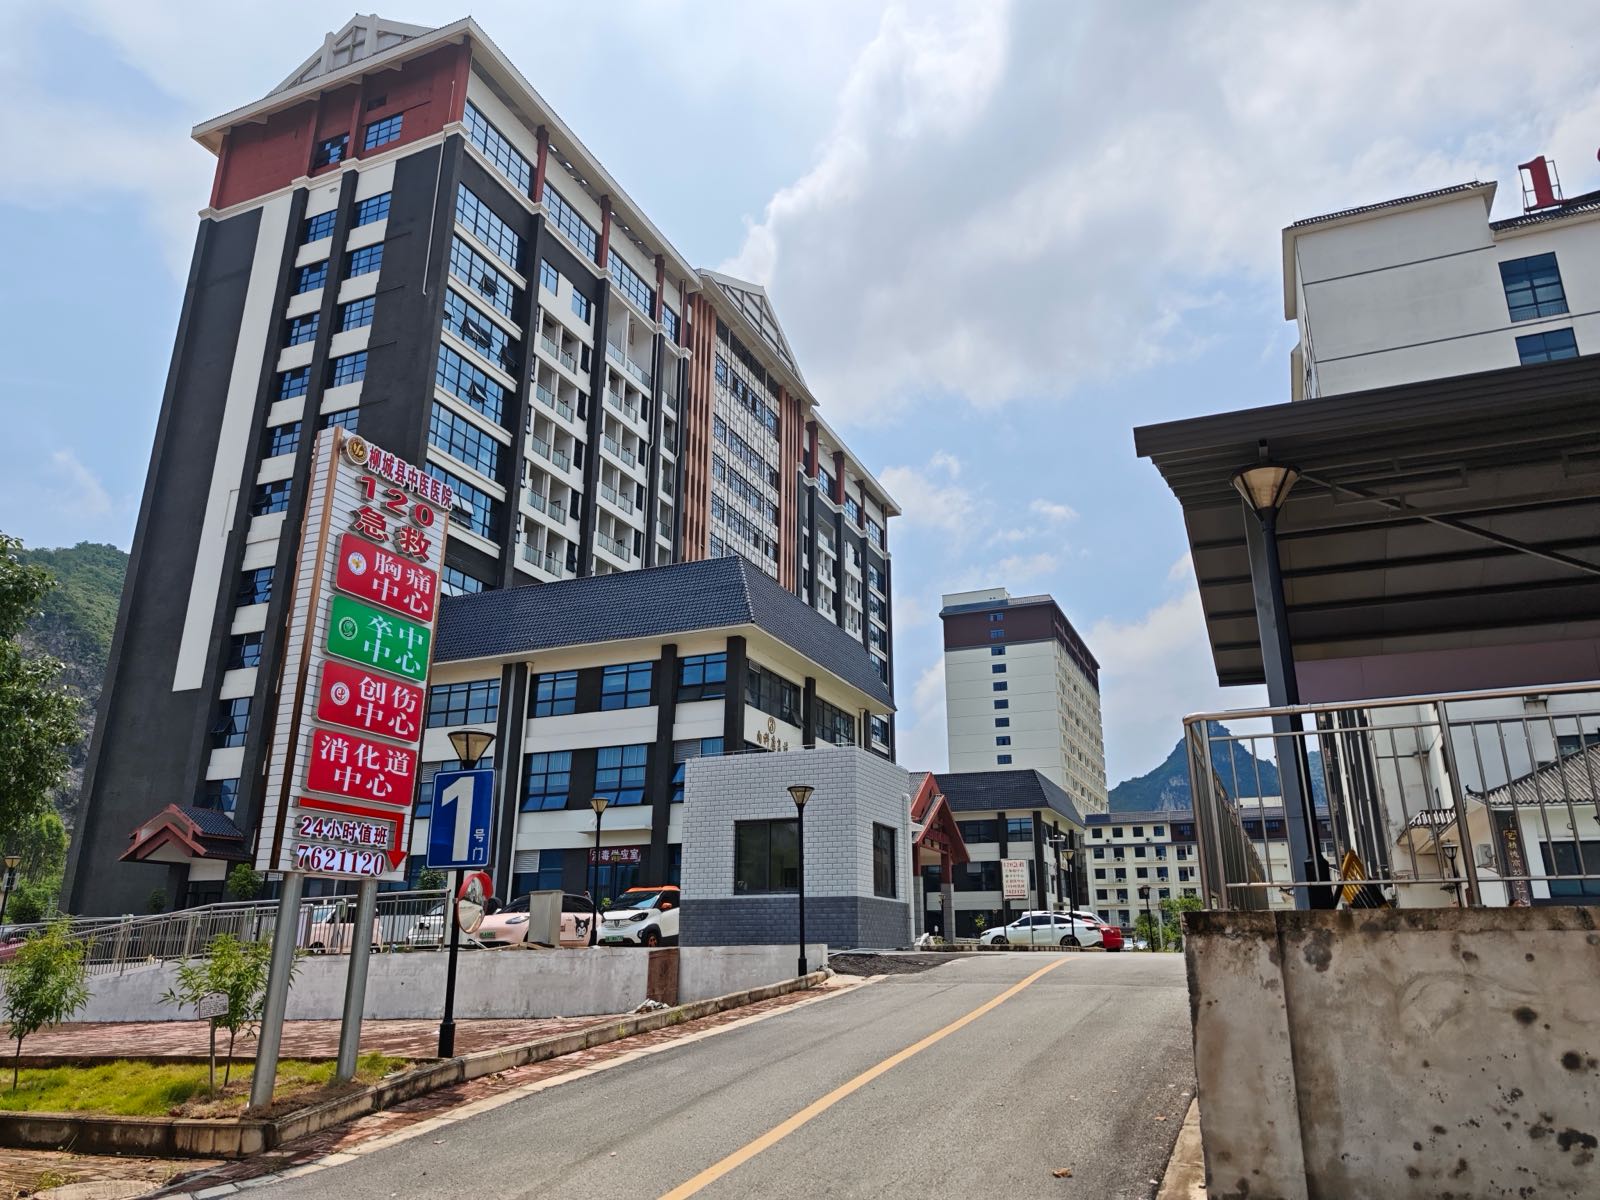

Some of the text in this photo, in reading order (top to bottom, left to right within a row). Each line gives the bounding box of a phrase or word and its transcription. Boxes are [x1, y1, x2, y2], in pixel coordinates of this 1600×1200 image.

[368, 445, 453, 510] 柳城县中医医院
[361, 476, 434, 527] 120
[354, 505, 431, 561] 急救
[374, 551, 431, 594] 胸痛
[372, 577, 429, 613] 中心
[367, 615, 424, 650] 卒中
[363, 639, 420, 673] 中心
[358, 676, 418, 713] 创伤
[356, 702, 414, 735] 中心
[320, 735, 410, 776] 消化道
[334, 766, 392, 797] 中心
[300, 816, 388, 845] 24小时值班
[441, 776, 485, 862] 1 号门
[297, 844, 385, 876] 7621120
